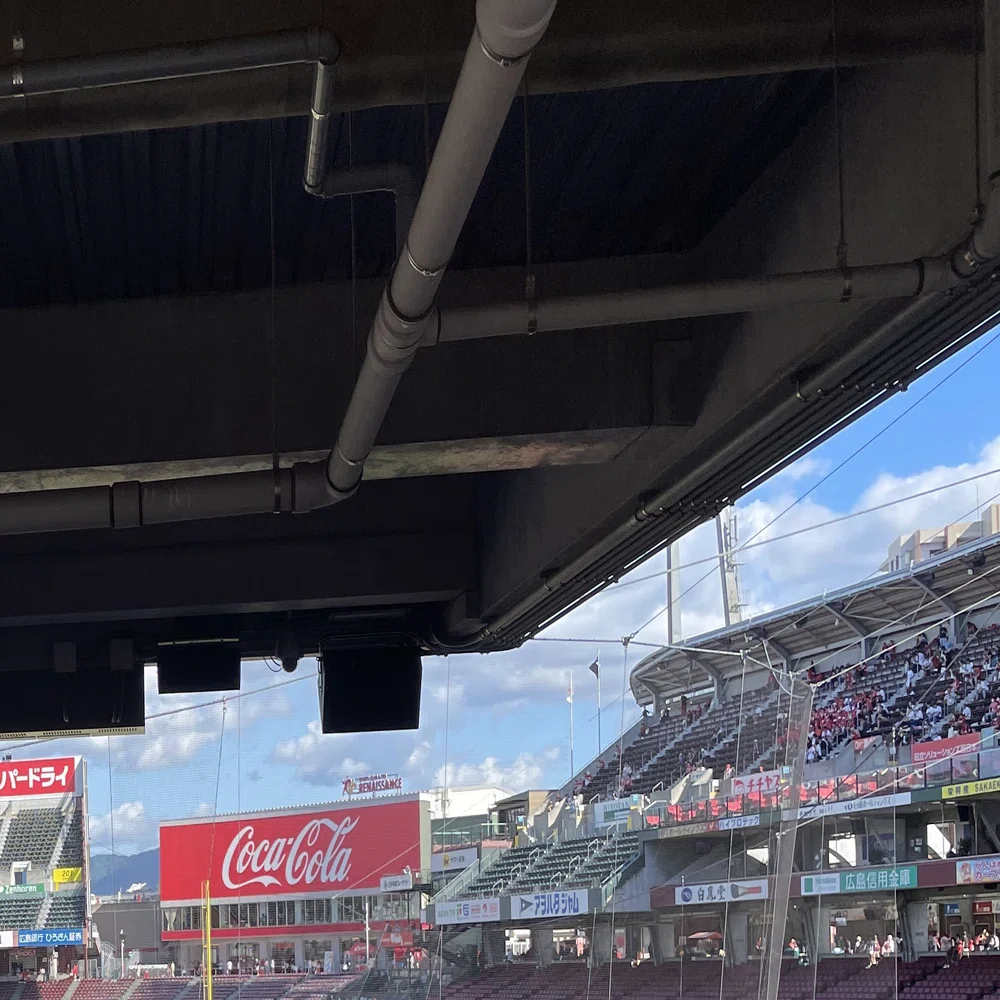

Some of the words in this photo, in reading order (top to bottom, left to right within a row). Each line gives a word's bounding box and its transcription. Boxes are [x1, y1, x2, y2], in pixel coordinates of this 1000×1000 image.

[222, 816, 360, 890] Coca-Cola
[845, 869, 911, 890] 広島信用金庫
[19, 932, 43, 943] 広島銀行
